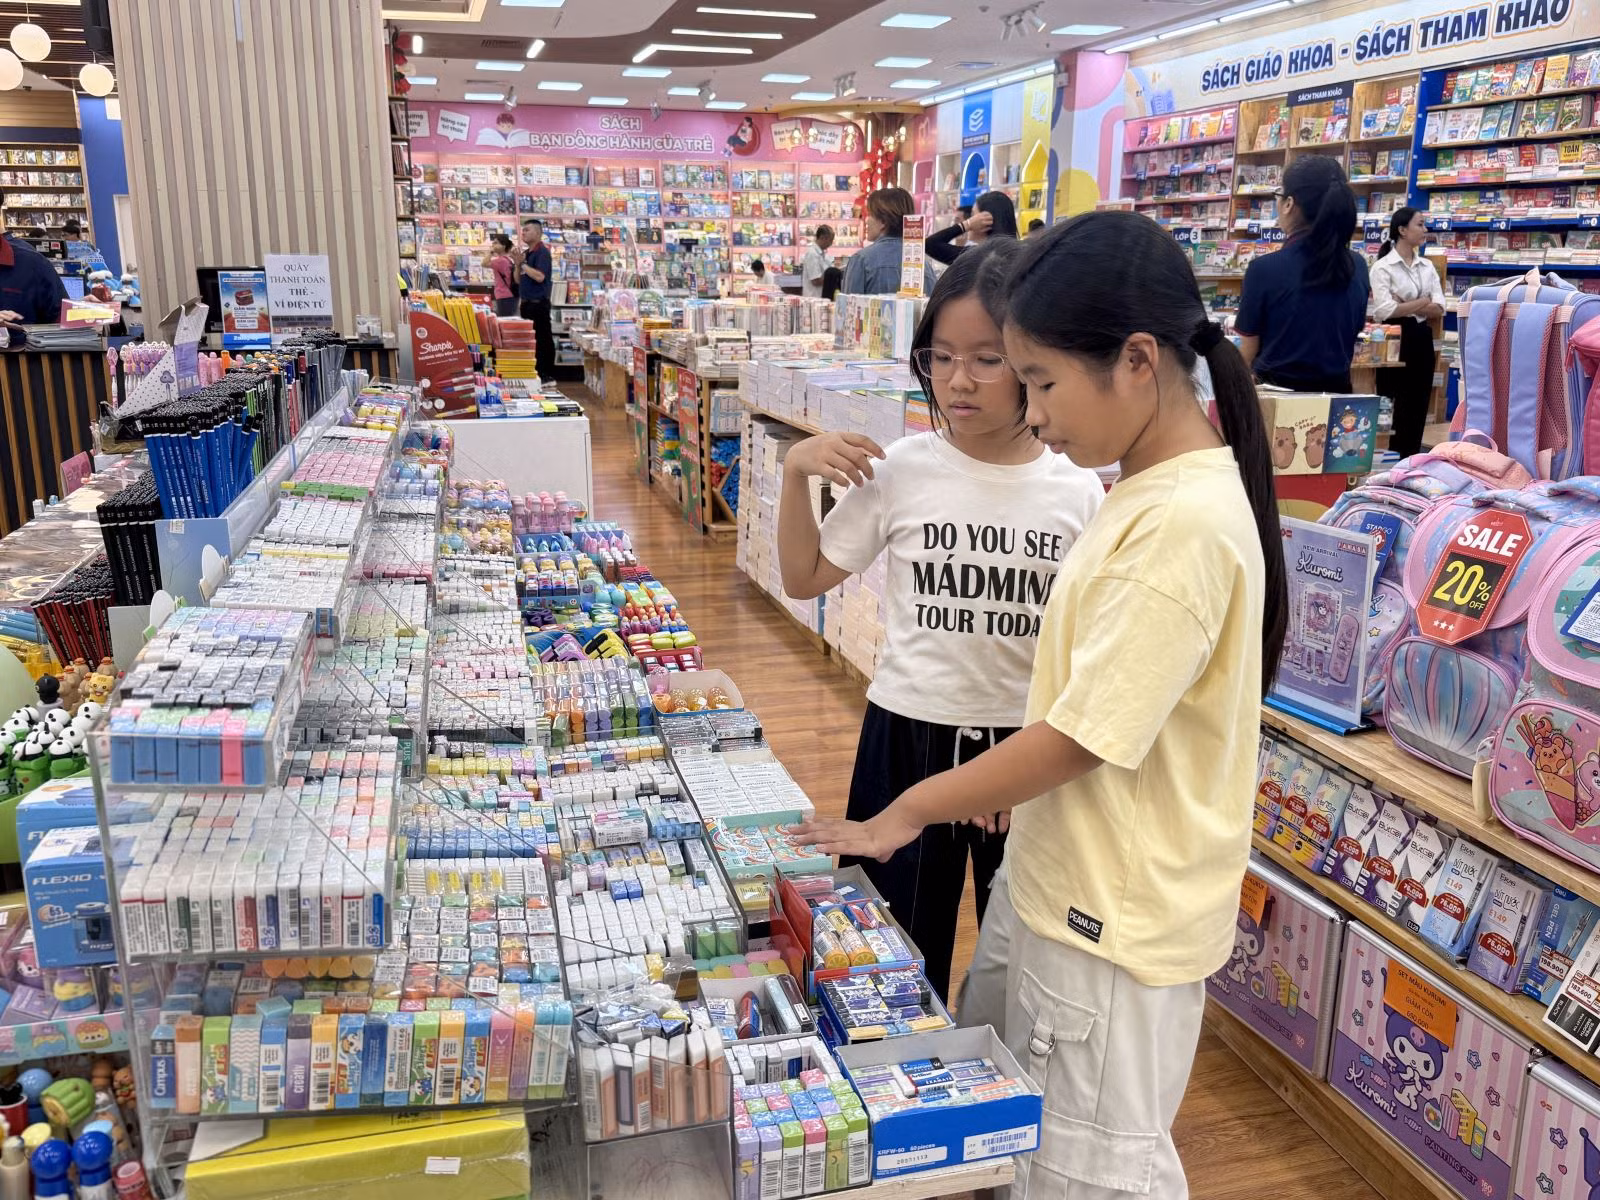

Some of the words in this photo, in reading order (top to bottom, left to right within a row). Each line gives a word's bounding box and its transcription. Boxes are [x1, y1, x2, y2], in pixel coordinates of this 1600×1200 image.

[1202, 63, 1240, 91] SÁCH
[1245, 51, 1282, 83] GIÁO
[1288, 43, 1333, 74] KHOA
[1341, 47, 1348, 55] -
[1355, 25, 1412, 60] SÁCH
[1420, 8, 1488, 48] THAM
[1298, 92, 1312, 101] SÁCH
[1312, 90, 1327, 99] THAM
[1327, 87, 1343, 97] KHẢO
[601, 115, 641, 130] SÁCH
[531, 133, 563, 152] BẠN
[564, 129, 607, 149] ĐỒNG
[610, 132, 651, 150] HÀNH
[653, 133, 684, 151] CỦA
[686, 135, 712, 152] TRẺ
[1564, 144, 1580, 153] TOÁN
[1175, 230, 1190, 240] LỚP
[1193, 231, 1199, 240] 3
[1367, 230, 1381, 240] LỚP
[283, 262, 310, 273] QUẦY
[269, 275, 301, 284] THANH
[302, 274, 326, 284] TOÁN
[289, 287, 309, 296] THẺ
[287, 299, 310, 310] ĐIỆN
[311, 299, 326, 309] TỬ
[420, 340, 454, 355] Sharpie
[923, 523, 957, 550] DO
[966, 523, 1015, 554] YOU
[1024, 530, 1062, 562] SEE
[1457, 524, 1523, 557] SALE
[1303, 544, 1315, 552] NEW
[1316, 548, 1339, 558] ARRIVAL
[1296, 551, 1343, 582] Kuromi
[1433, 560, 1492, 606] 20%
[1469, 600, 1486, 611] OFF
[915, 603, 975, 633] TOUR
[983, 610, 1043, 637] TODA
[32, 873, 92, 886] FLEXIO
[1446, 877, 1463, 892] E149
[1489, 908, 1508, 924] E149
[1551, 903, 1560, 919] GEL
[1069, 910, 1100, 934] PEANUTS
[1545, 920, 1555, 939] PEN
[1398, 969, 1409, 981] SET
[1570, 982, 1592, 1001] 183.600
[155, 1059, 166, 1096] Campus
[1345, 1060, 1397, 1120] Kuromi
[917, 1143, 936, 1151] pieces
[1424, 1135, 1461, 1173] PAINTING
[1459, 1165, 1477, 1186] SET
